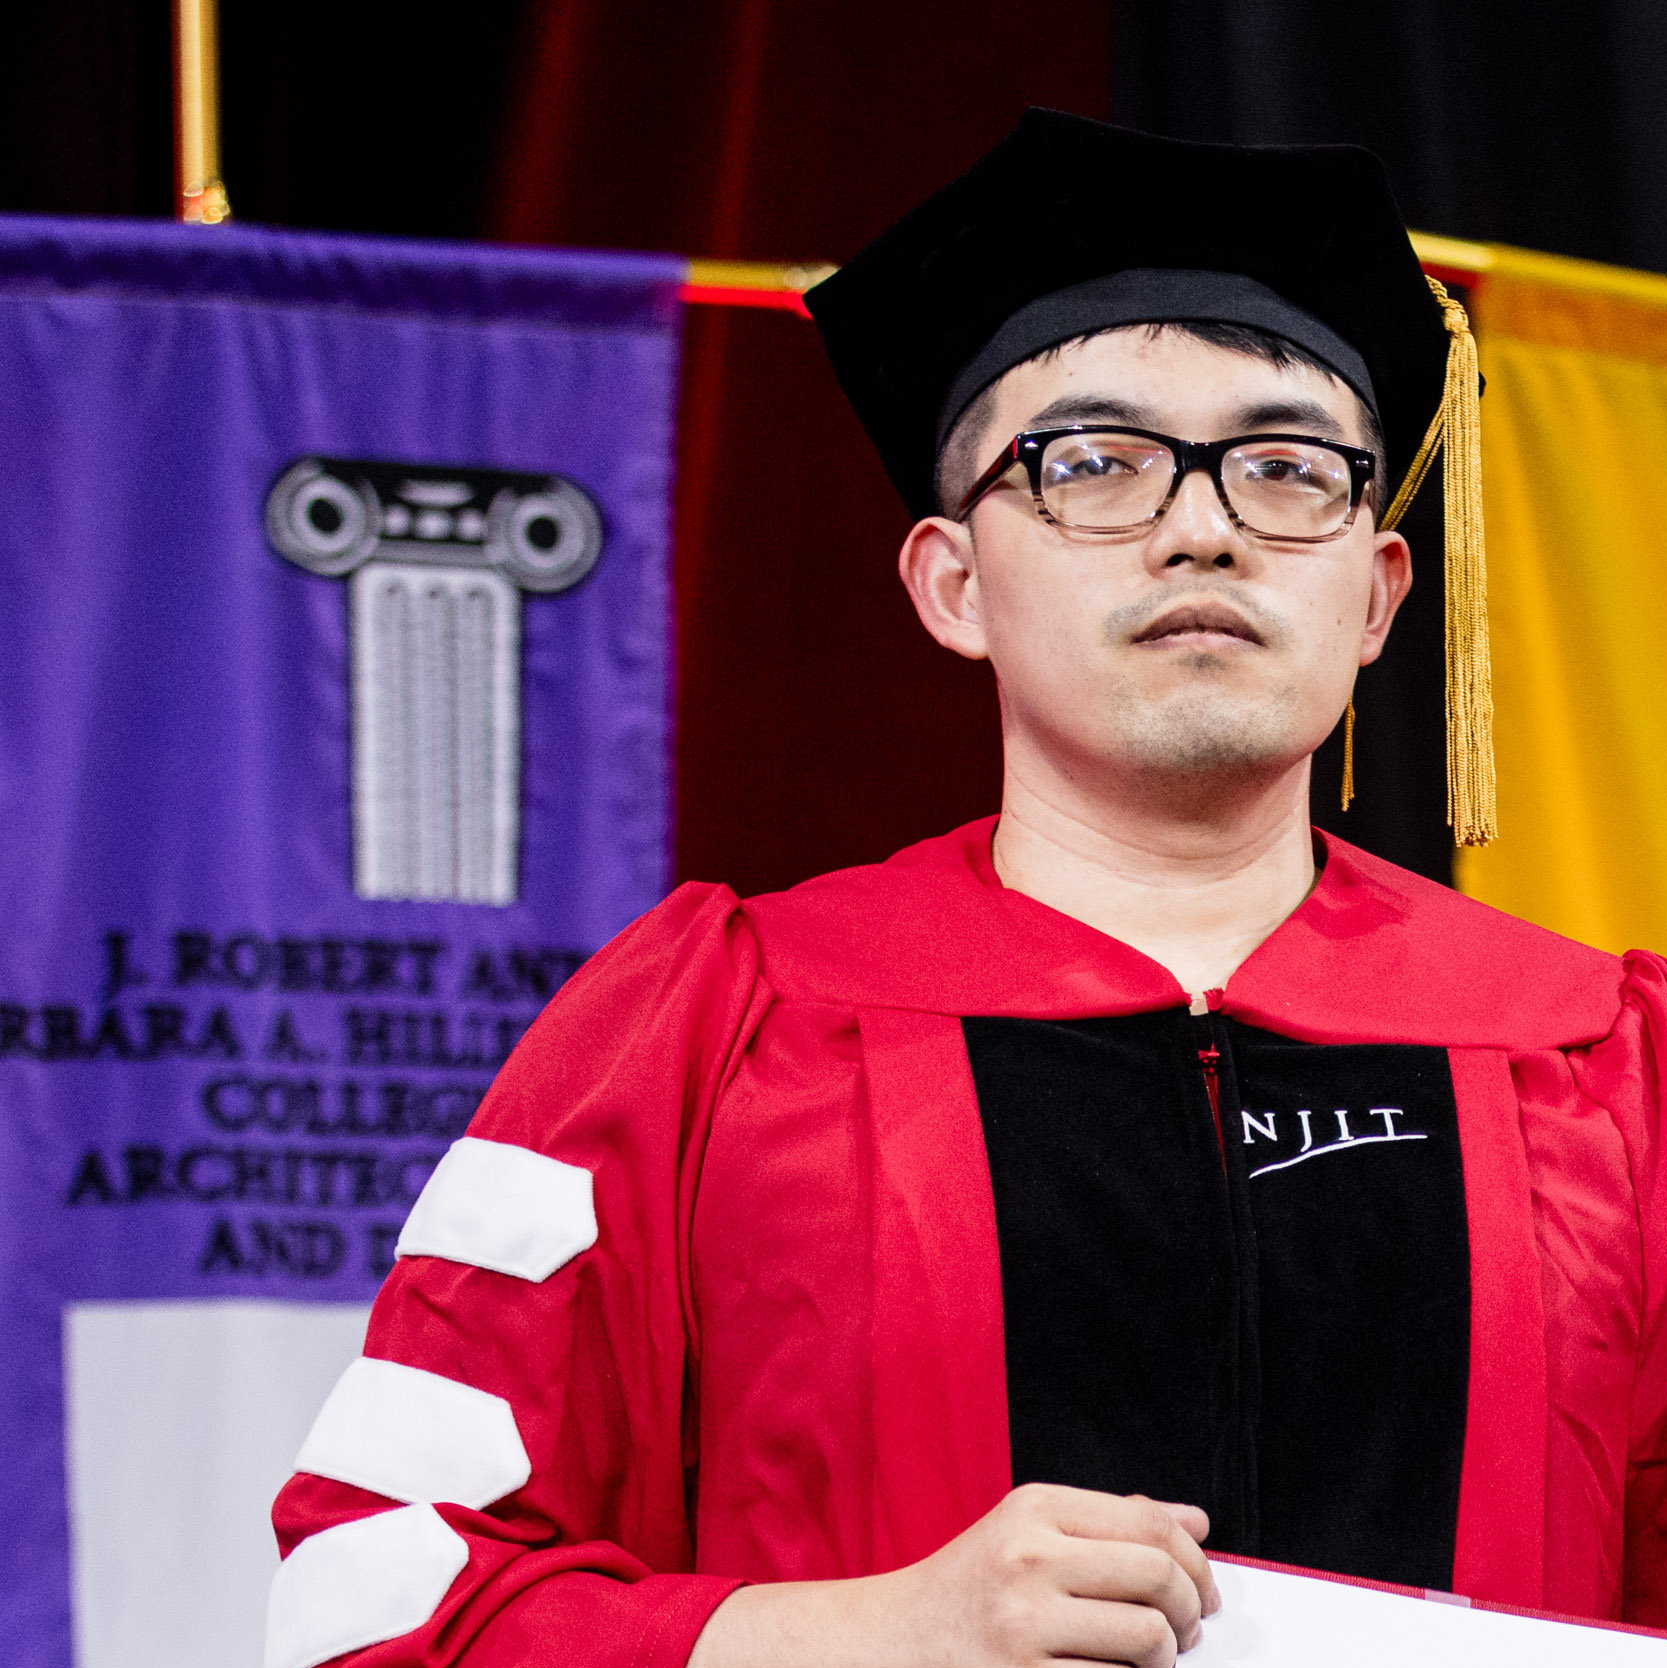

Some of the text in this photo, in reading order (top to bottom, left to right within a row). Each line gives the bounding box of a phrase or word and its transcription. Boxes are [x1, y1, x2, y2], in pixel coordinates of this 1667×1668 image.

[172, 930, 443, 997] ROBERT
[203, 1073, 484, 1138] COLLEG
[1241, 1107, 1404, 1153] NJIT
[200, 1216, 347, 1281] AND
